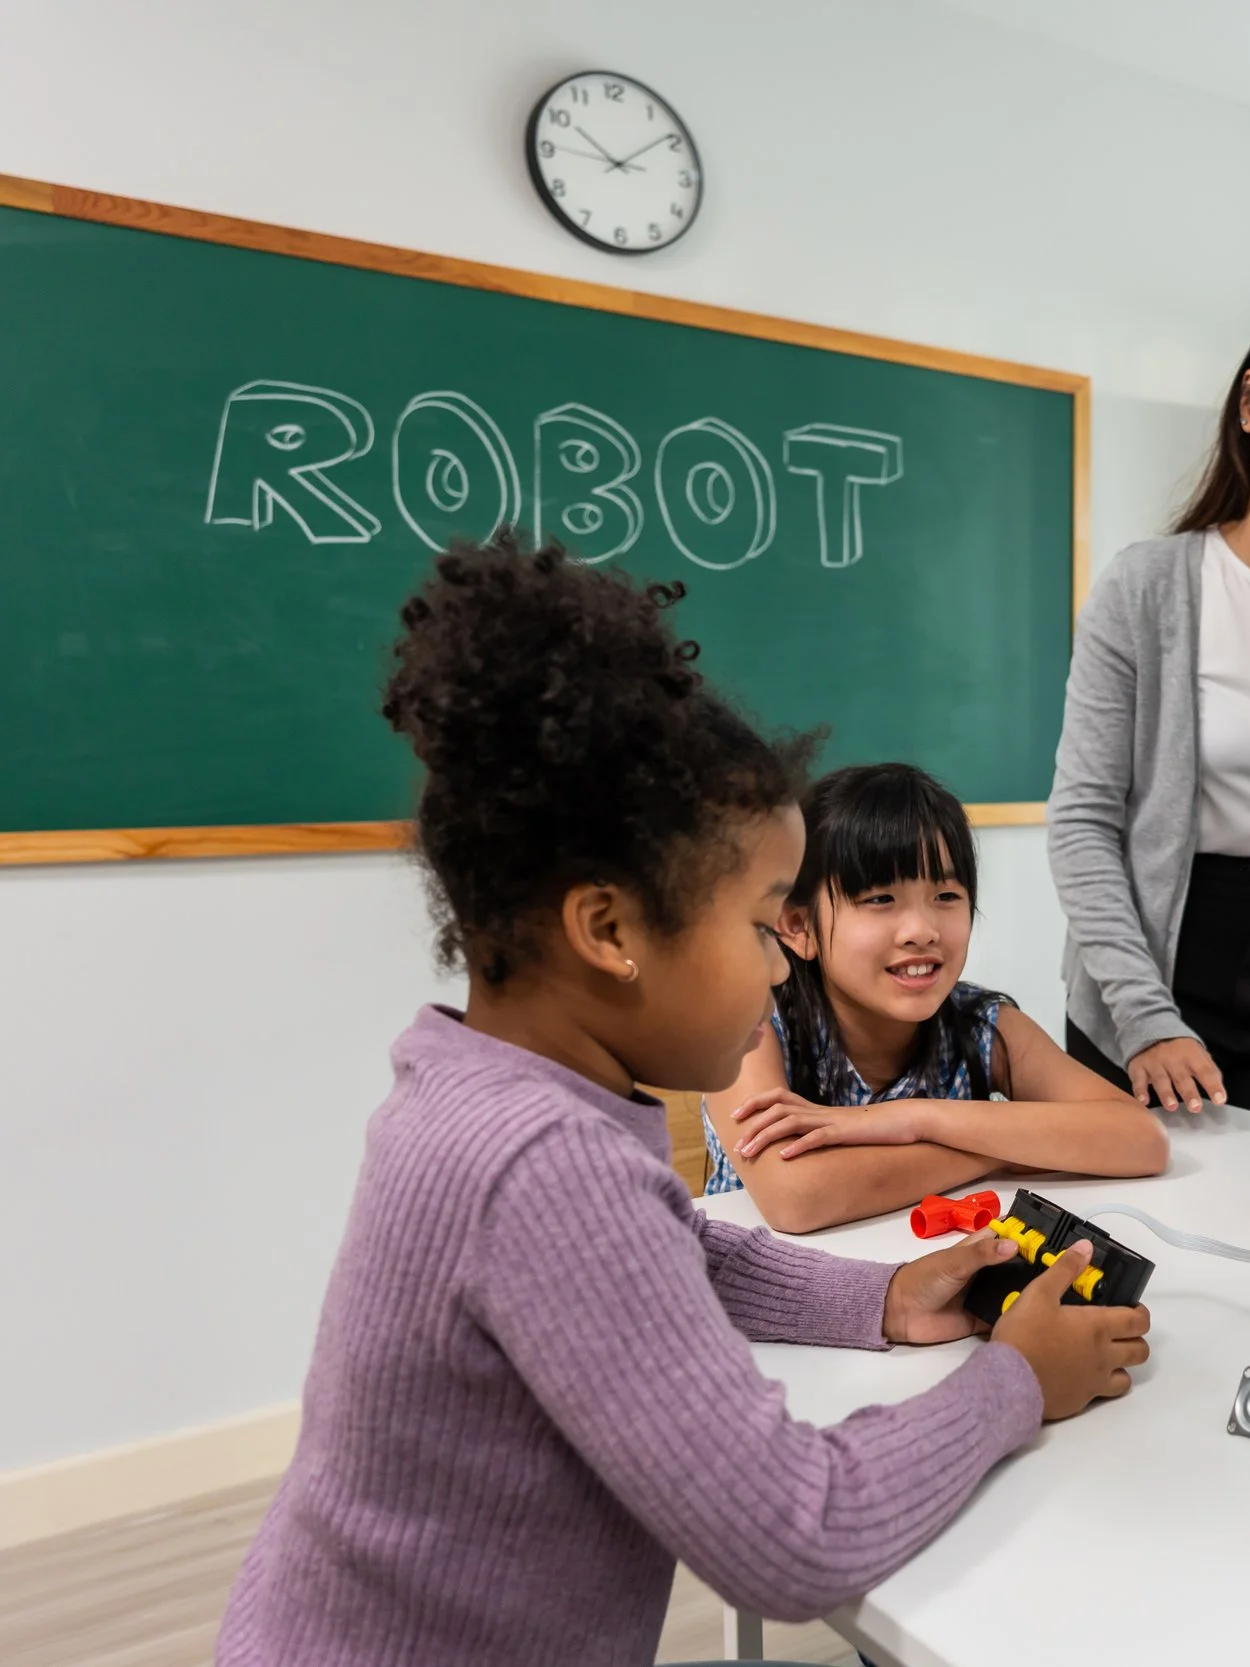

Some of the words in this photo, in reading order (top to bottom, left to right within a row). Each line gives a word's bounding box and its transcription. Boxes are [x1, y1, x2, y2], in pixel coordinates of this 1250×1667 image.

[570, 86, 589, 106] 11
[604, 82, 625, 103] 12
[549, 108, 571, 128] 10
[646, 105, 654, 121] 1
[541, 140, 555, 158] 9
[667, 134, 682, 152] 2
[551, 179, 566, 197] 8
[678, 170, 693, 188] 3
[579, 209, 592, 227] 7
[670, 203, 684, 219] 4
[614, 227, 628, 245] 6
[648, 223, 662, 241] 5
[204, 378, 904, 571] ROBOT
